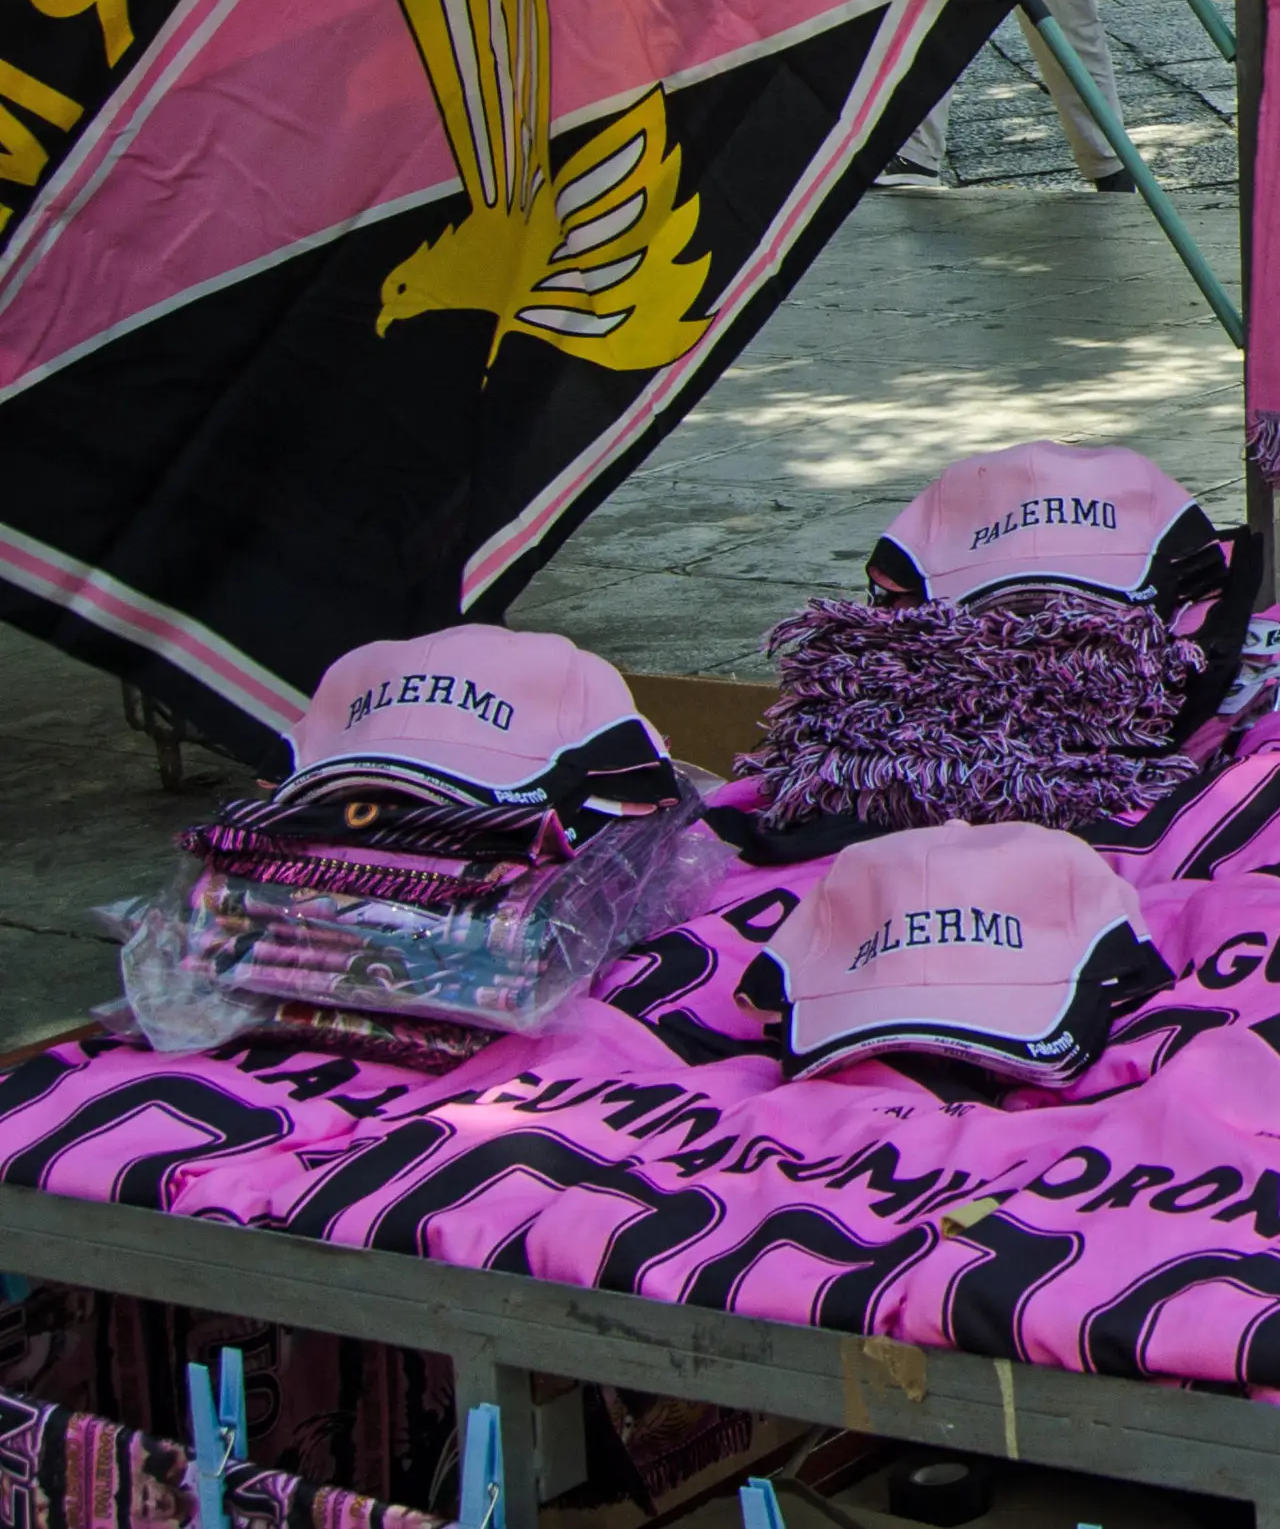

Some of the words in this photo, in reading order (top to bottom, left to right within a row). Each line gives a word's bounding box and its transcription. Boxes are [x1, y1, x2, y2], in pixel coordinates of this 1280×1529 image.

[969, 497, 1117, 551] PALERMO
[345, 674, 515, 731] PALERMO
[848, 906, 1025, 972] PALERMO
